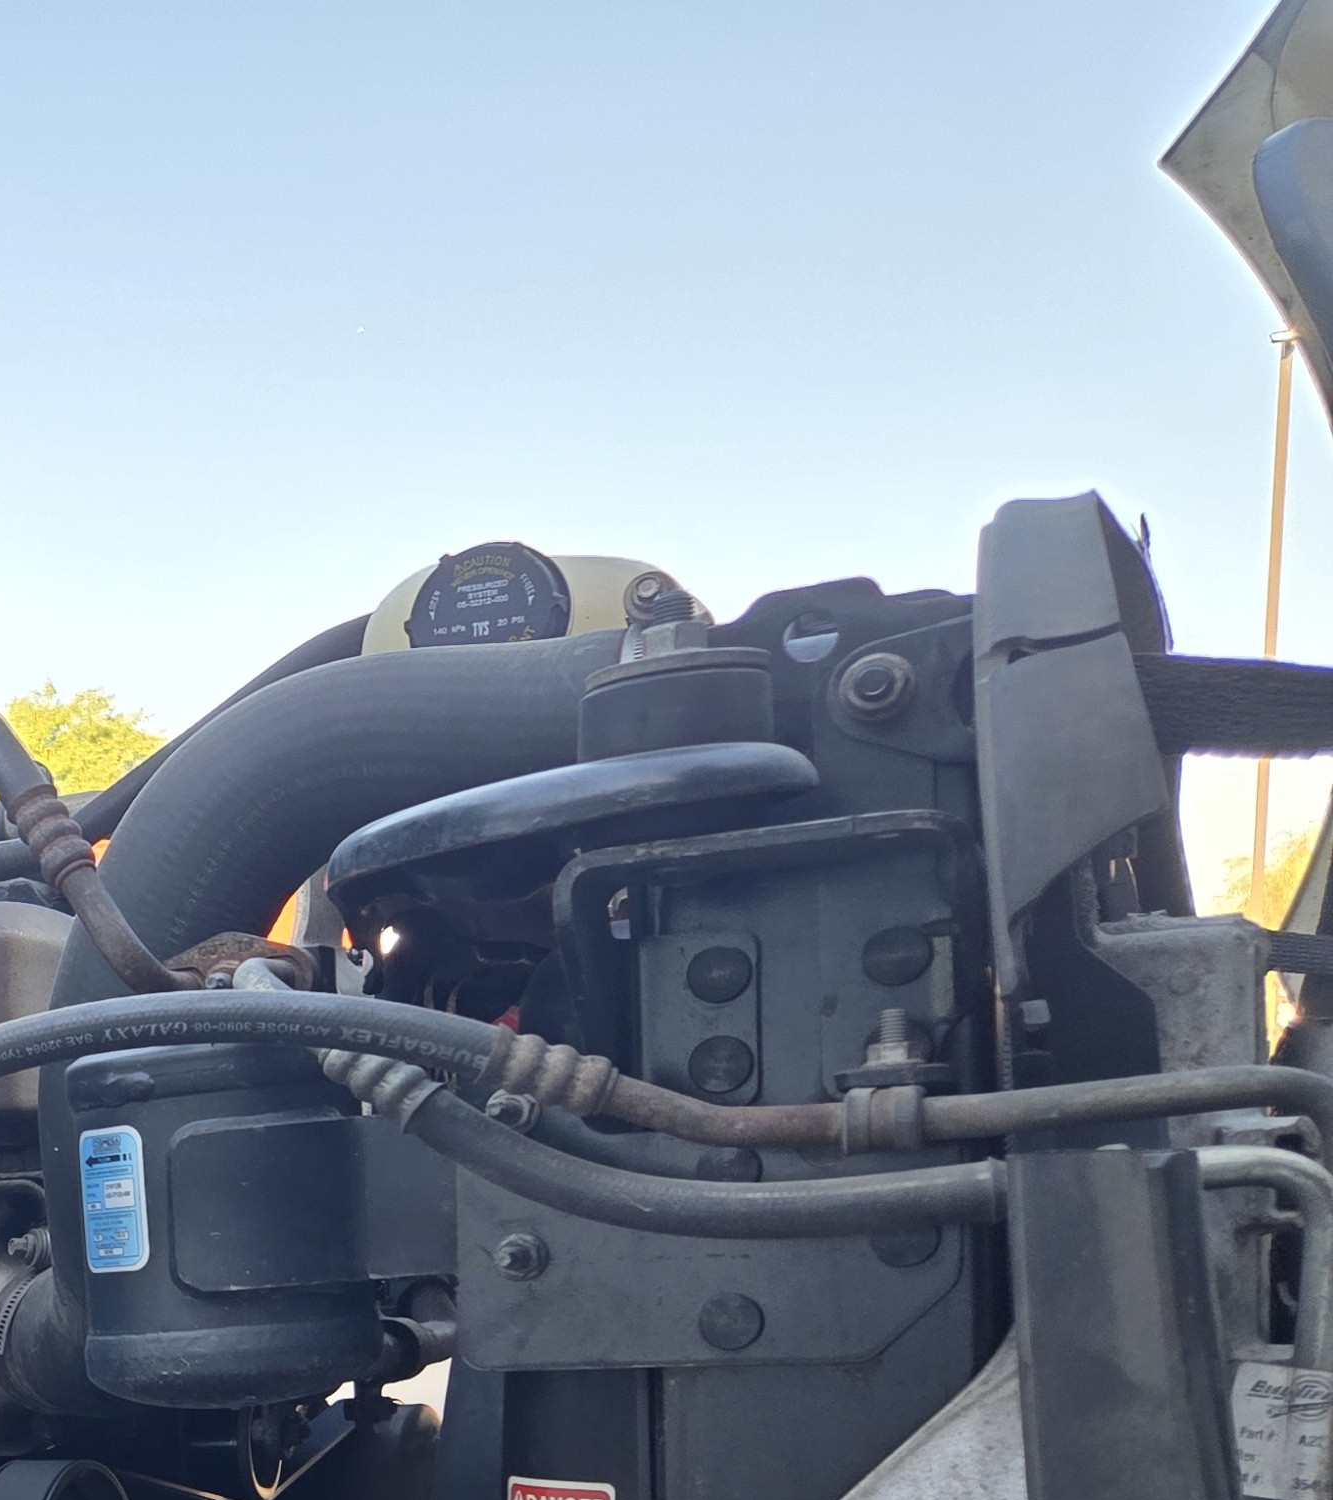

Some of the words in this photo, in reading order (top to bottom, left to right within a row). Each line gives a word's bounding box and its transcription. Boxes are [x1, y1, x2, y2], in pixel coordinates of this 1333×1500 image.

[463, 554, 511, 571] CAUTION
[467, 589, 499, 599] SYSTEM
[433, 627, 447, 635] 140
[472, 621, 490, 637] TVS
[496, 618, 508, 627] 20
[511, 615, 525, 625] PSI
[100, 1021, 188, 1043] GALAXY
[256, 1021, 300, 1034] HOSE
[26, 1038, 63, 1057] J2064
[64, 1033, 94, 1045] SAE
[339, 1025, 491, 1070] BURGAFLEX
